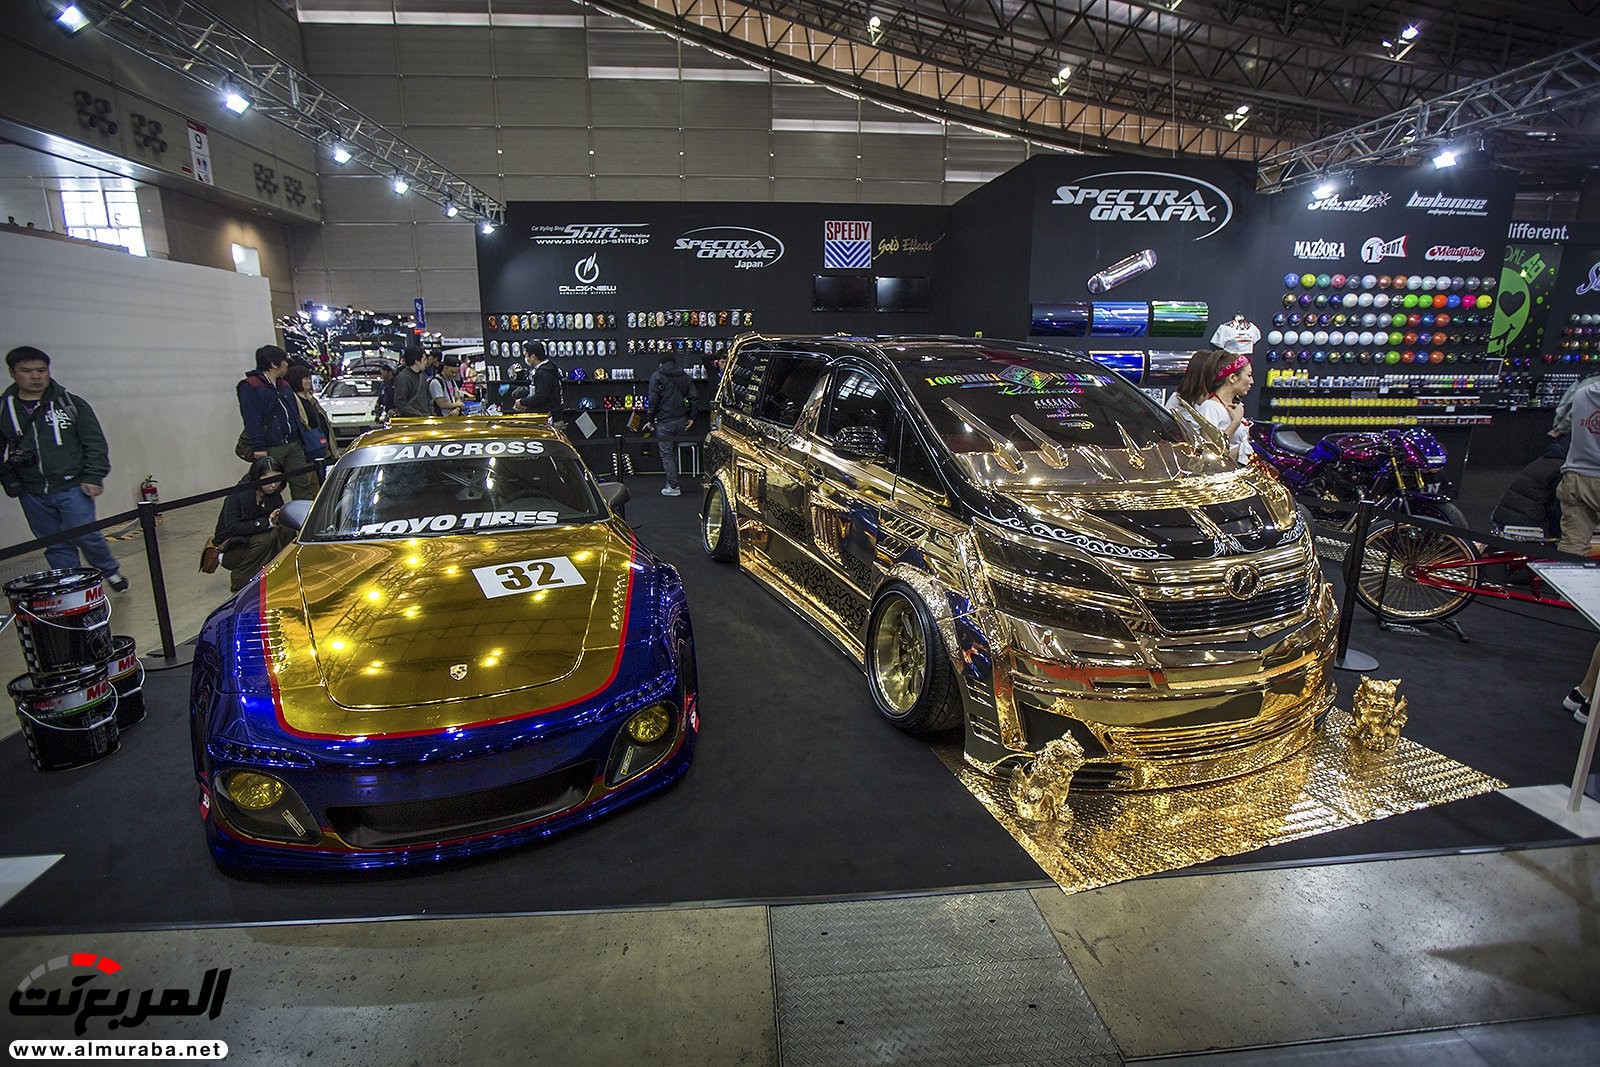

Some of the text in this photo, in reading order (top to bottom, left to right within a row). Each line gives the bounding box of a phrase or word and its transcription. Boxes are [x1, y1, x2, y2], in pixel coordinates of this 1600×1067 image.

[1051, 185, 1206, 206] SPECTRA
[1405, 190, 1489, 210] balance
[564, 223, 621, 239] Shift
[825, 221, 870, 241] SPEEDY
[536, 238, 649, 246] www.showup-shift.jp
[673, 238, 766, 250] SPECTRA
[873, 235, 936, 258] Gold Effects
[1381, 241, 1401, 255] SHOT
[696, 249, 777, 259] CHROME
[734, 259, 764, 270] Japan
[373, 441, 545, 462] PANCROSS
[360, 510, 559, 535] TOYO TIRES
[494, 561, 565, 591] 32
